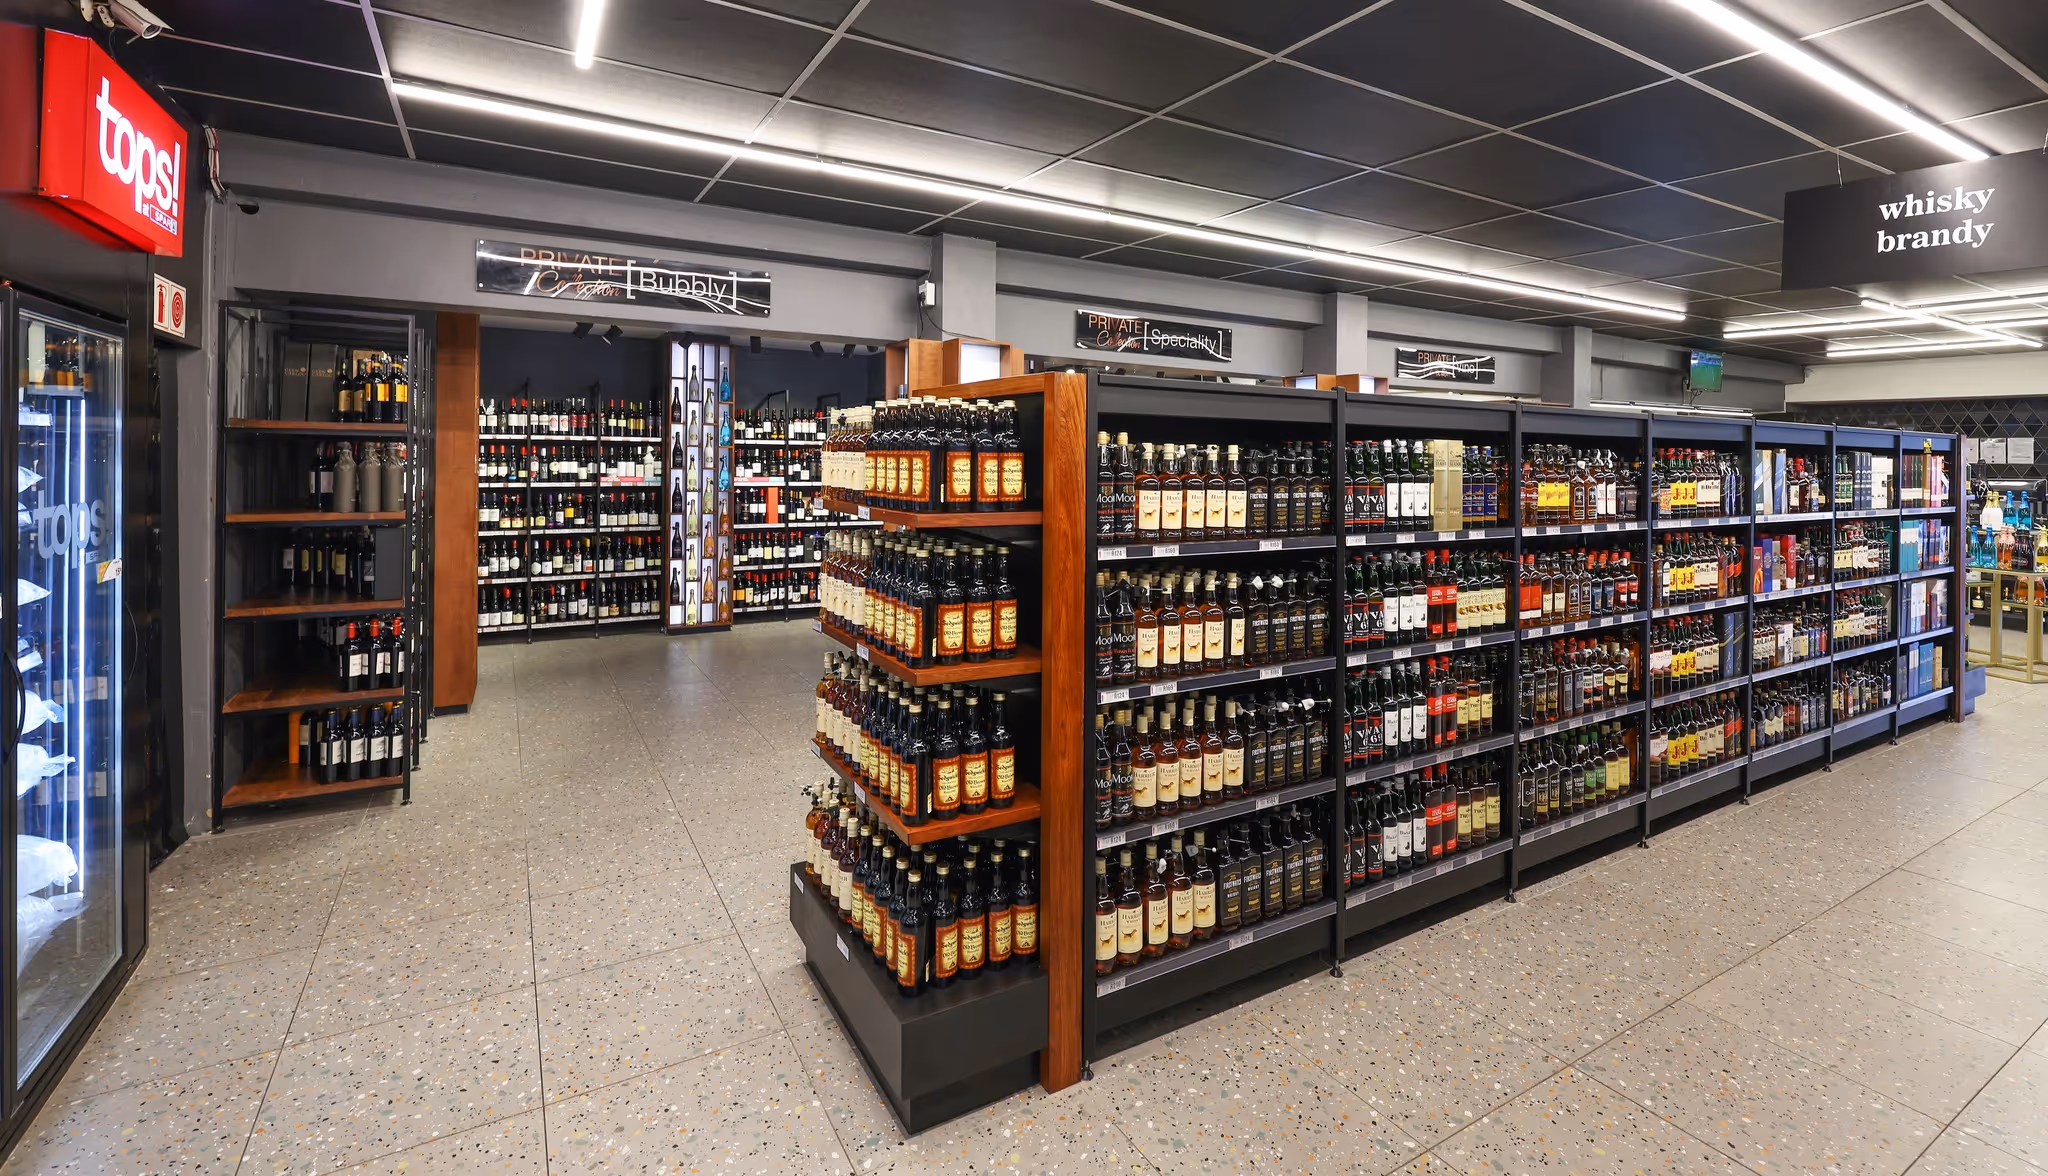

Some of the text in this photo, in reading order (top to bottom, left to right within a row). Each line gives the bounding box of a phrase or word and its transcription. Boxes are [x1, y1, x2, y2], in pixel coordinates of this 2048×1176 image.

[96, 76, 181, 218] tops!
[142, 202, 172, 231] at SPAR
[1878, 186, 1995, 220] whisky
[1876, 218, 1994, 254] brandy
[520, 247, 623, 277] PRIVATE
[536, 270, 622, 298] Collection
[1088, 313, 1143, 335] PRIVATE
[1096, 330, 1141, 349] Collection
